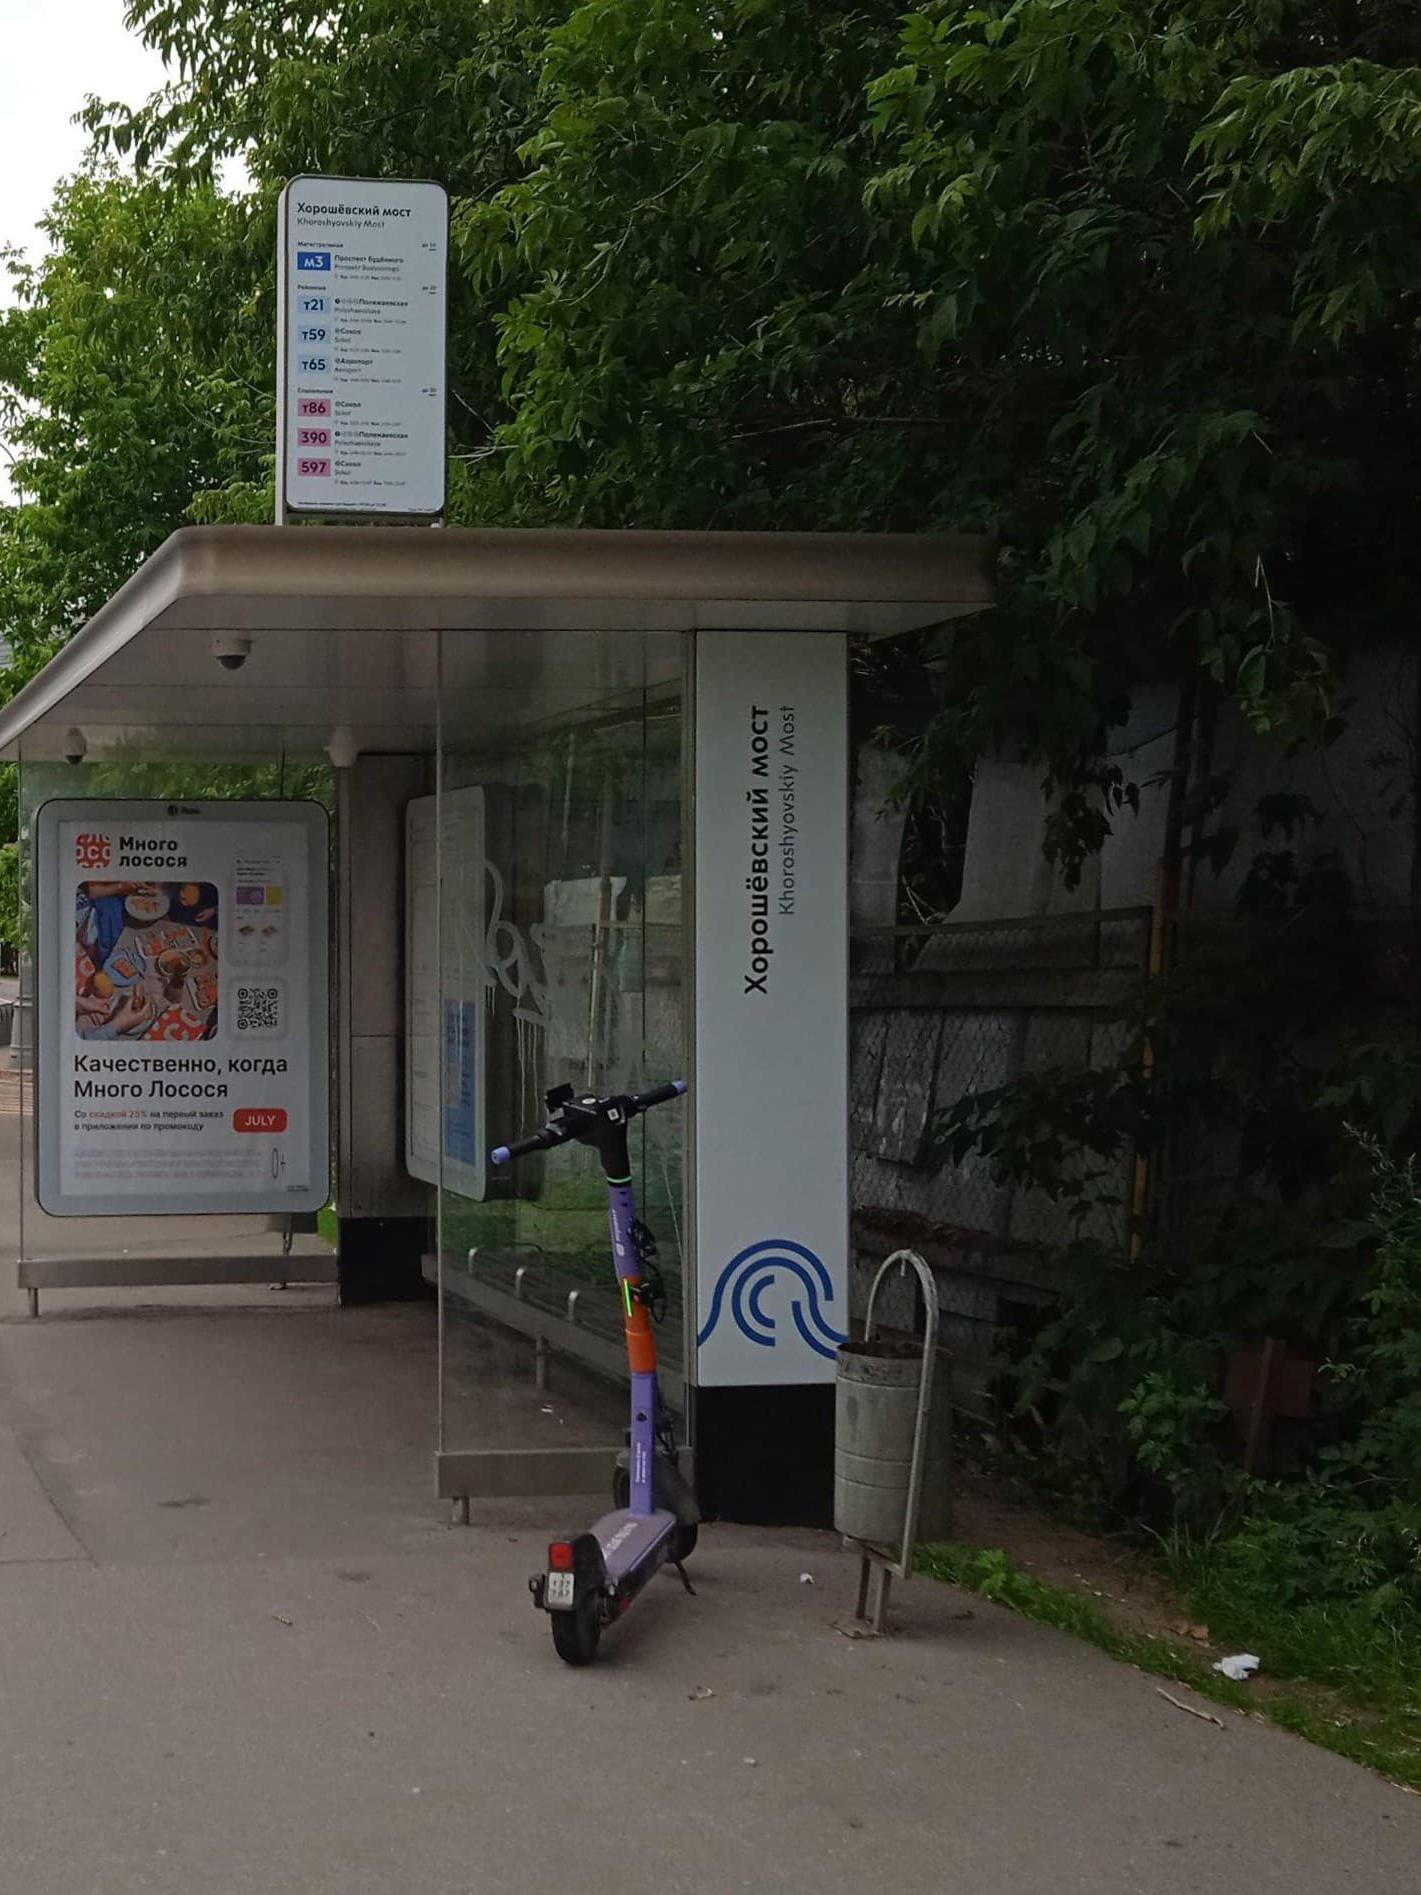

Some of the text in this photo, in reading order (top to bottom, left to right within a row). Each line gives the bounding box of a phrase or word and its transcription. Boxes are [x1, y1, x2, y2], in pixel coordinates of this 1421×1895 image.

[297, 202, 411, 217] Хорошёвский мост
[297, 218, 362, 229] Khoroshyovskiy
[302, 402, 326, 414] т86
[301, 431, 328, 444] 390
[301, 461, 327, 474] 597
[778, 704, 799, 916] Khoroshyovskiy Most
[119, 836, 179, 852] Много
[743, 705, 774, 996] Хорошёвский мост
[119, 855, 188, 869] лосося
[74, 1055, 288, 1076] Качественно, когда
[74, 1080, 228, 1099] Много Лосося
[74, 1109, 88, 1119] Со
[244, 1114, 275, 1127] JULY
